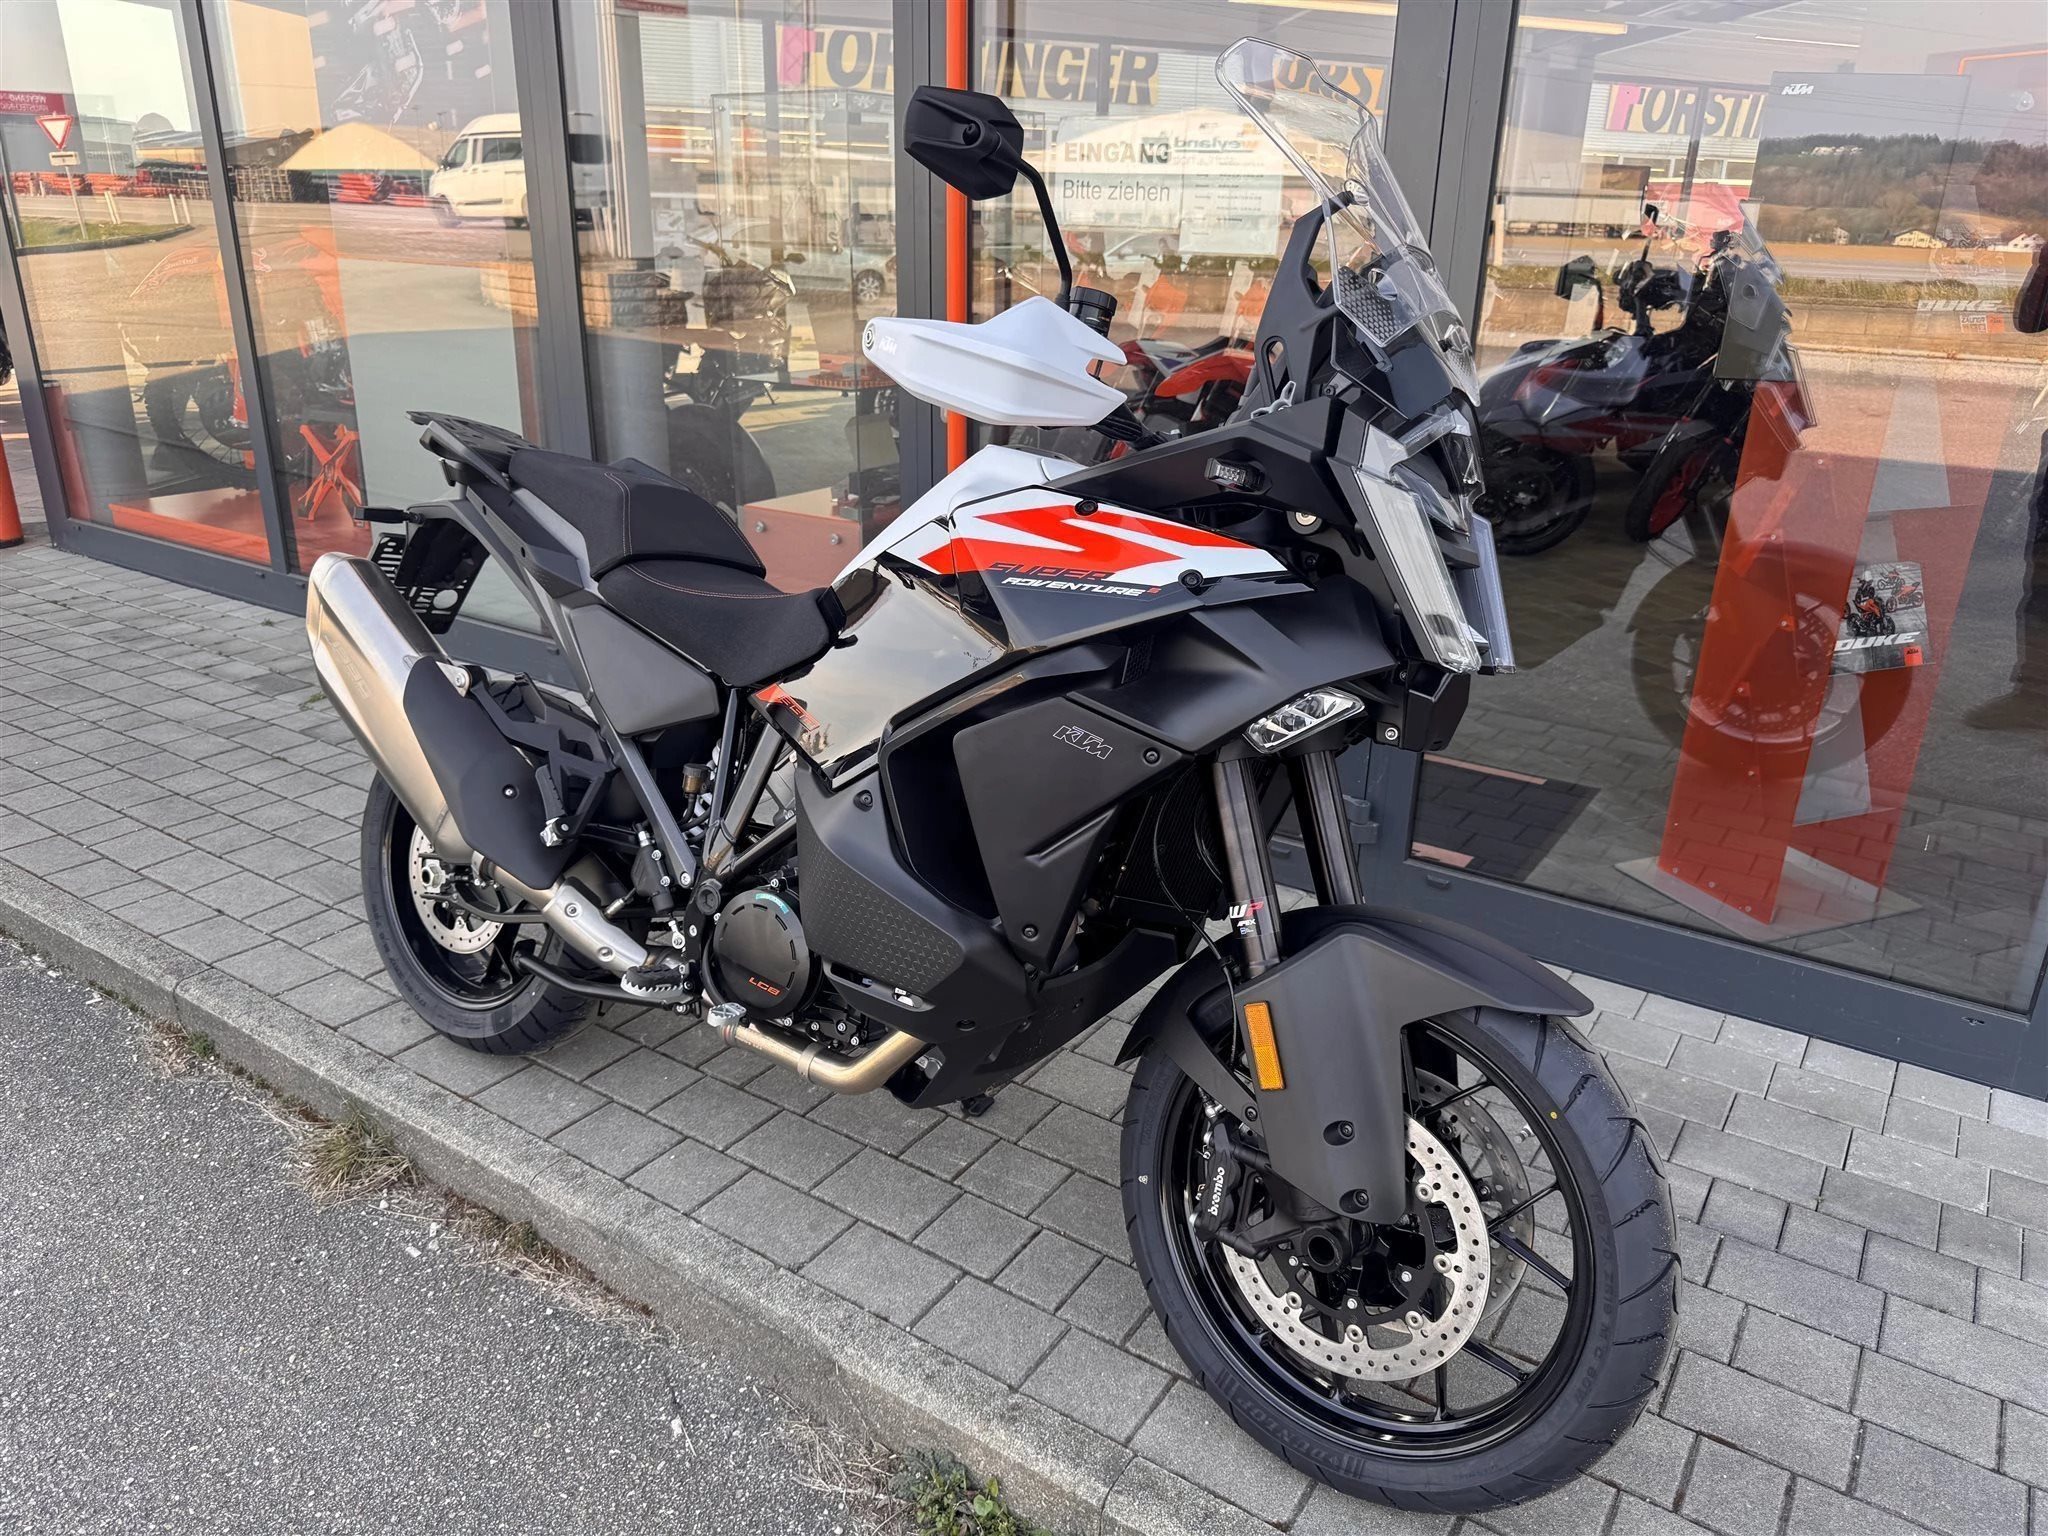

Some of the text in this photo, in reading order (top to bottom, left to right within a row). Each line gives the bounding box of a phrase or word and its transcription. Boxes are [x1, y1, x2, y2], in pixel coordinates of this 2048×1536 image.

[1781, 83, 1815, 96] KTM
[1063, 141, 1170, 164] EINGANG
[1063, 179, 1170, 201] Bitte ziehen
[986, 562, 1116, 581] SUPER
[1001, 576, 1146, 597] ADVENTURE
[1833, 631, 1921, 652] DUKE
[1052, 725, 1113, 760] KTM
[749, 976, 780, 996] LC8
[1208, 1167, 1225, 1216] brembo
